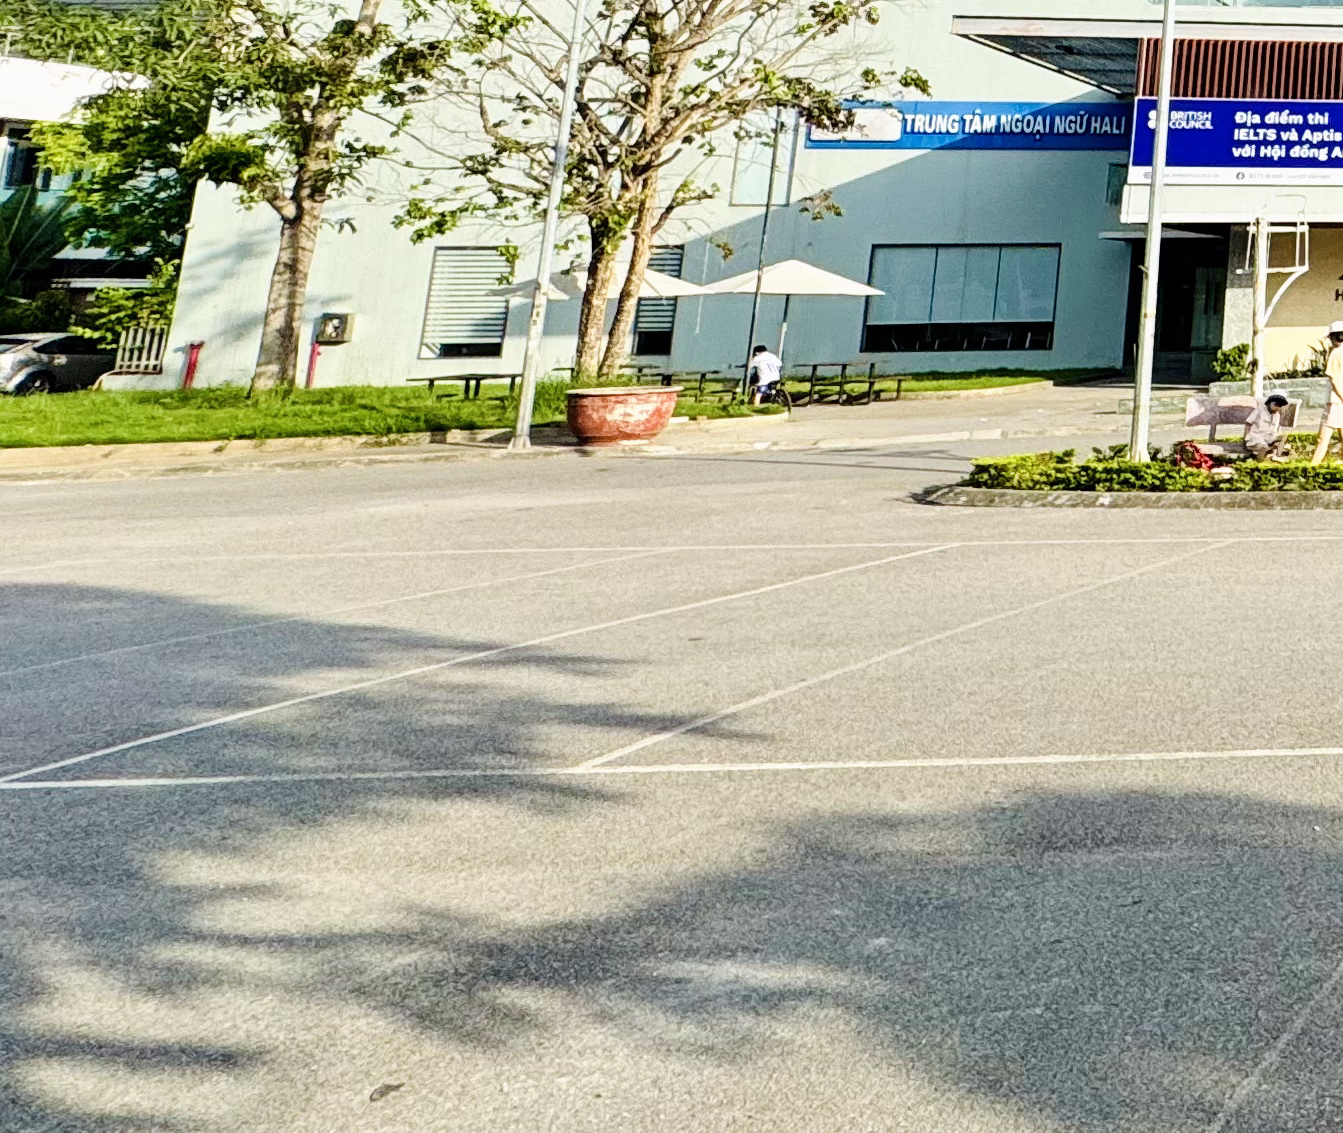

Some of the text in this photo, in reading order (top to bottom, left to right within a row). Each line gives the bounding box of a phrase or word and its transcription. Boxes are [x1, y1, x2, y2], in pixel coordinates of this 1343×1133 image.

[905, 108, 1126, 140] TRUNG TÂM NGOẠI NGỮ HALI
[1170, 111, 1212, 121] BRITISH
[1234, 109, 1329, 127] Địa điểm thi
[1169, 120, 1214, 130] COUNCIL
[1233, 128, 1277, 141] IELTS
[1280, 129, 1299, 142] và
[1301, 128, 1342, 144] Aptis
[1232, 145, 1256, 159] với
[1260, 144, 1286, 161] Hội
[1289, 144, 1329, 162] đồng
